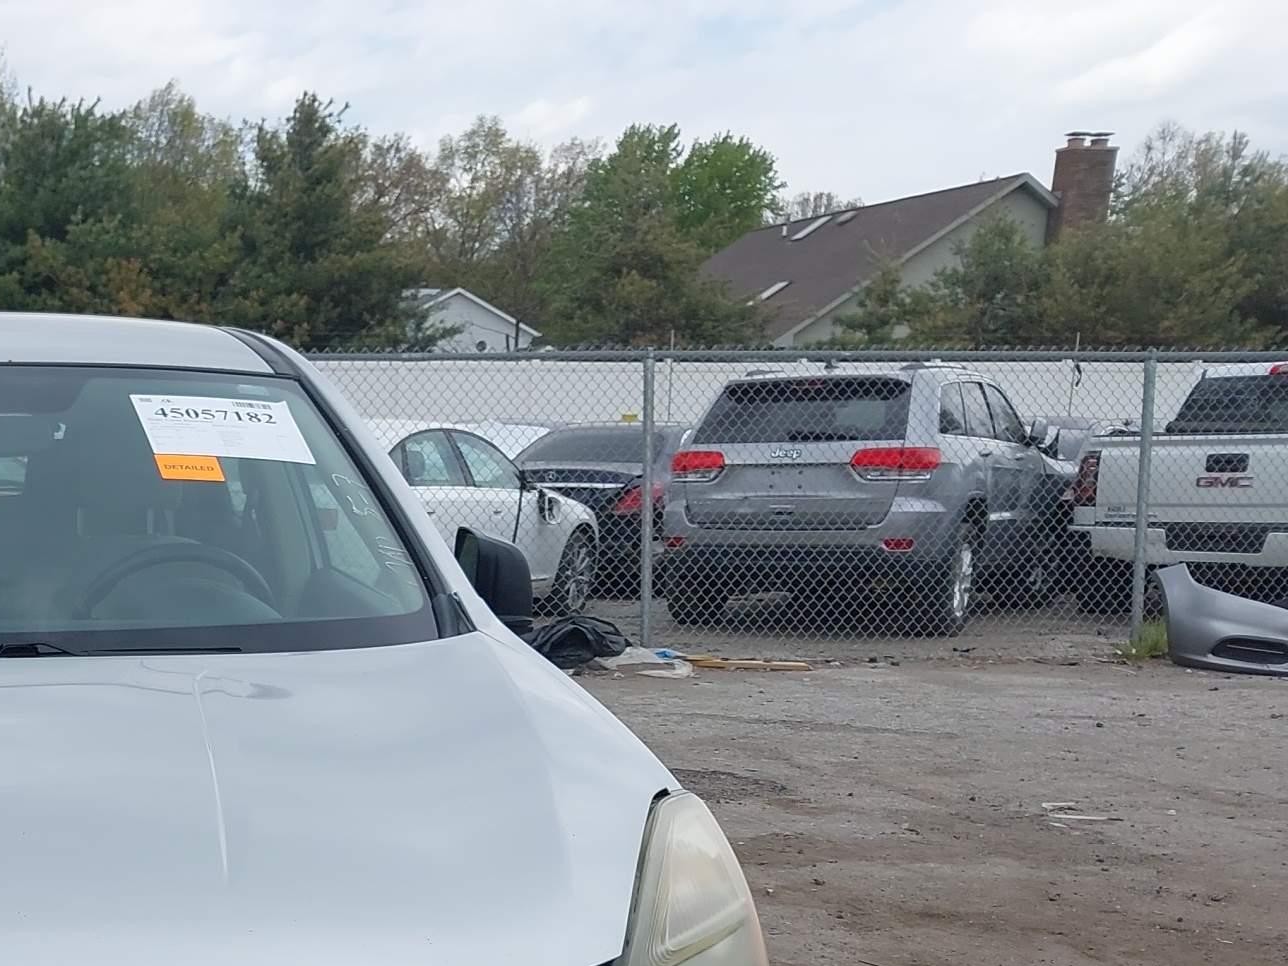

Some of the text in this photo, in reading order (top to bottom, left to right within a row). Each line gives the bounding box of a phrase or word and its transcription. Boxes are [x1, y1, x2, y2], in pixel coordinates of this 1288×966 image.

[154, 407, 277, 424] 45057182
[771, 448, 801, 459] Jeep
[1196, 476, 1255, 488] GMC
